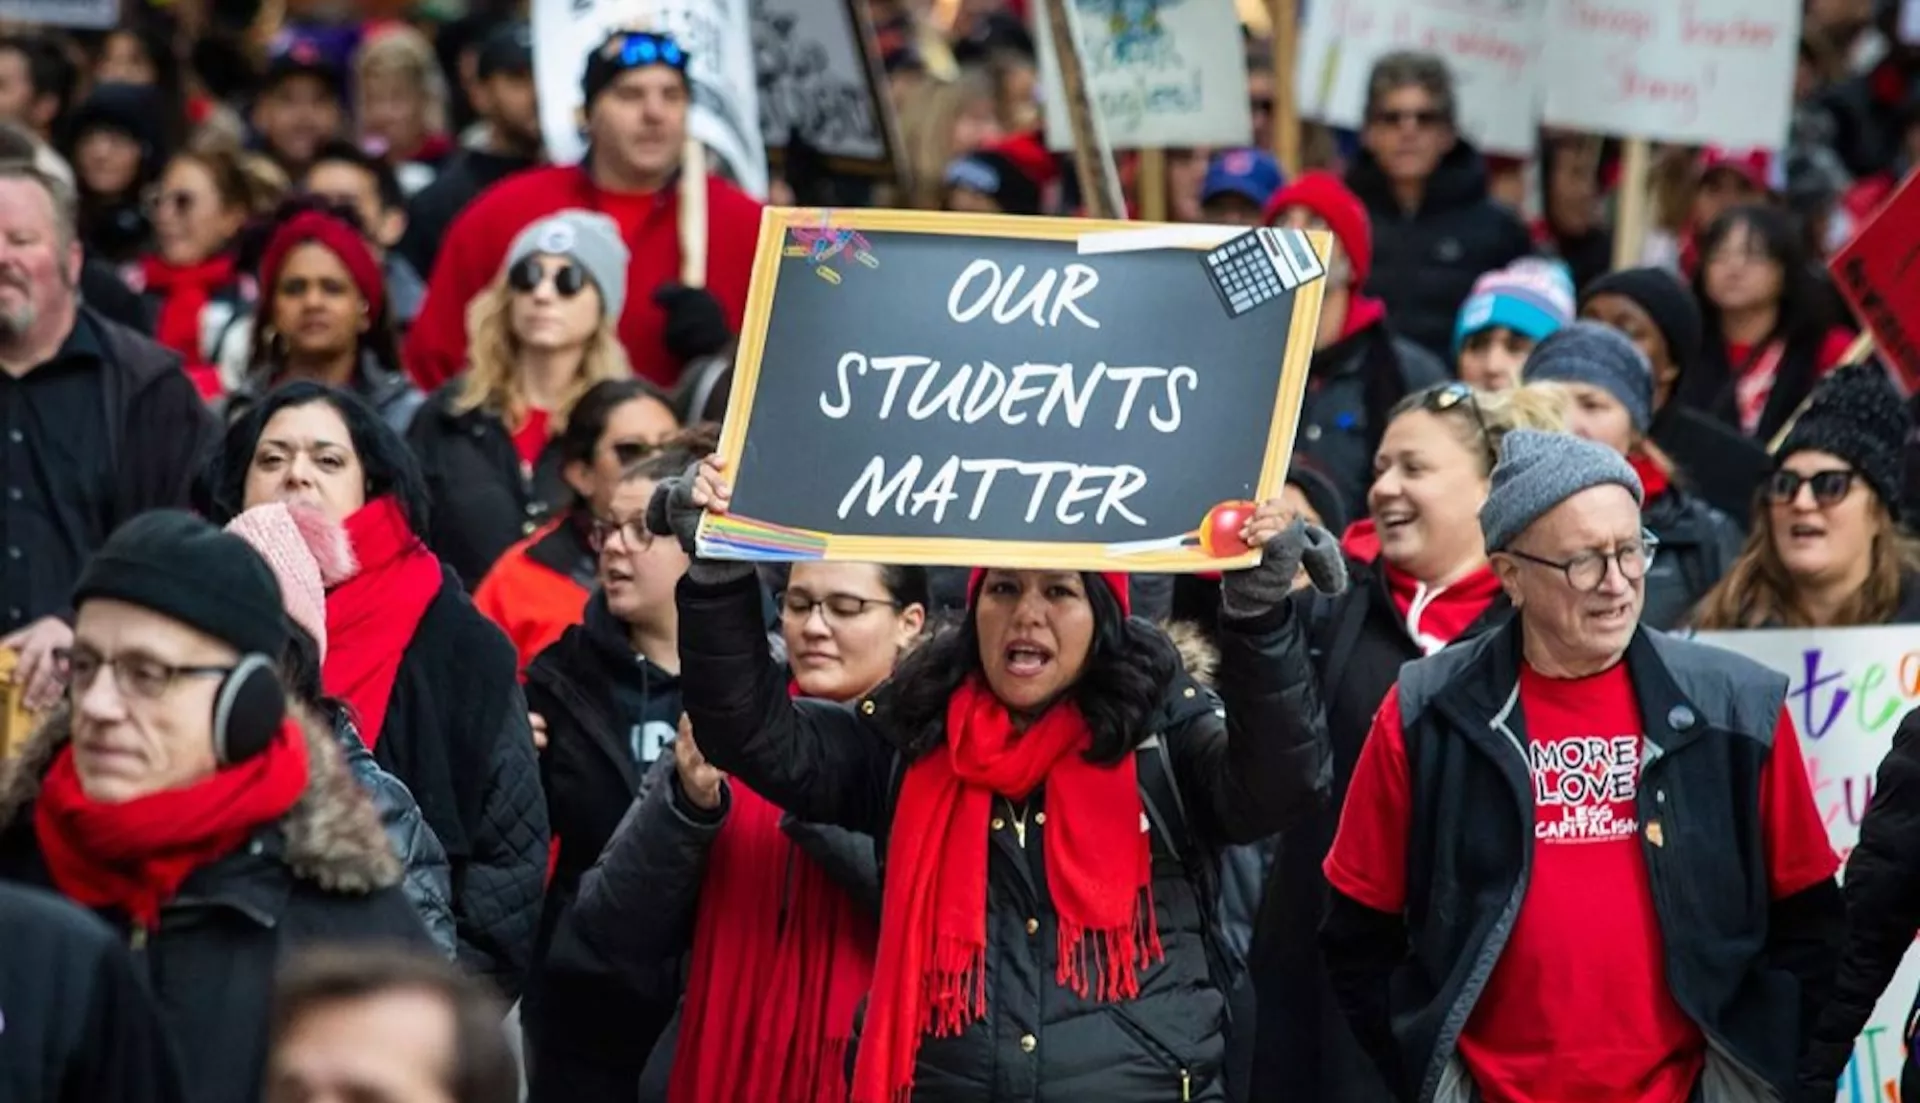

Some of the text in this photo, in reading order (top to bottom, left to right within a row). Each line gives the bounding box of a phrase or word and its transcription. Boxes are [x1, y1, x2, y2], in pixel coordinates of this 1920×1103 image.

[948, 259, 1099, 328] OUR
[820, 353, 1197, 432] STUDENTS
[838, 456, 1146, 524] MATTER
[1531, 736, 1638, 772] MORE
[1536, 771, 1637, 805] LOVE
[1562, 805, 1613, 822] LESS
